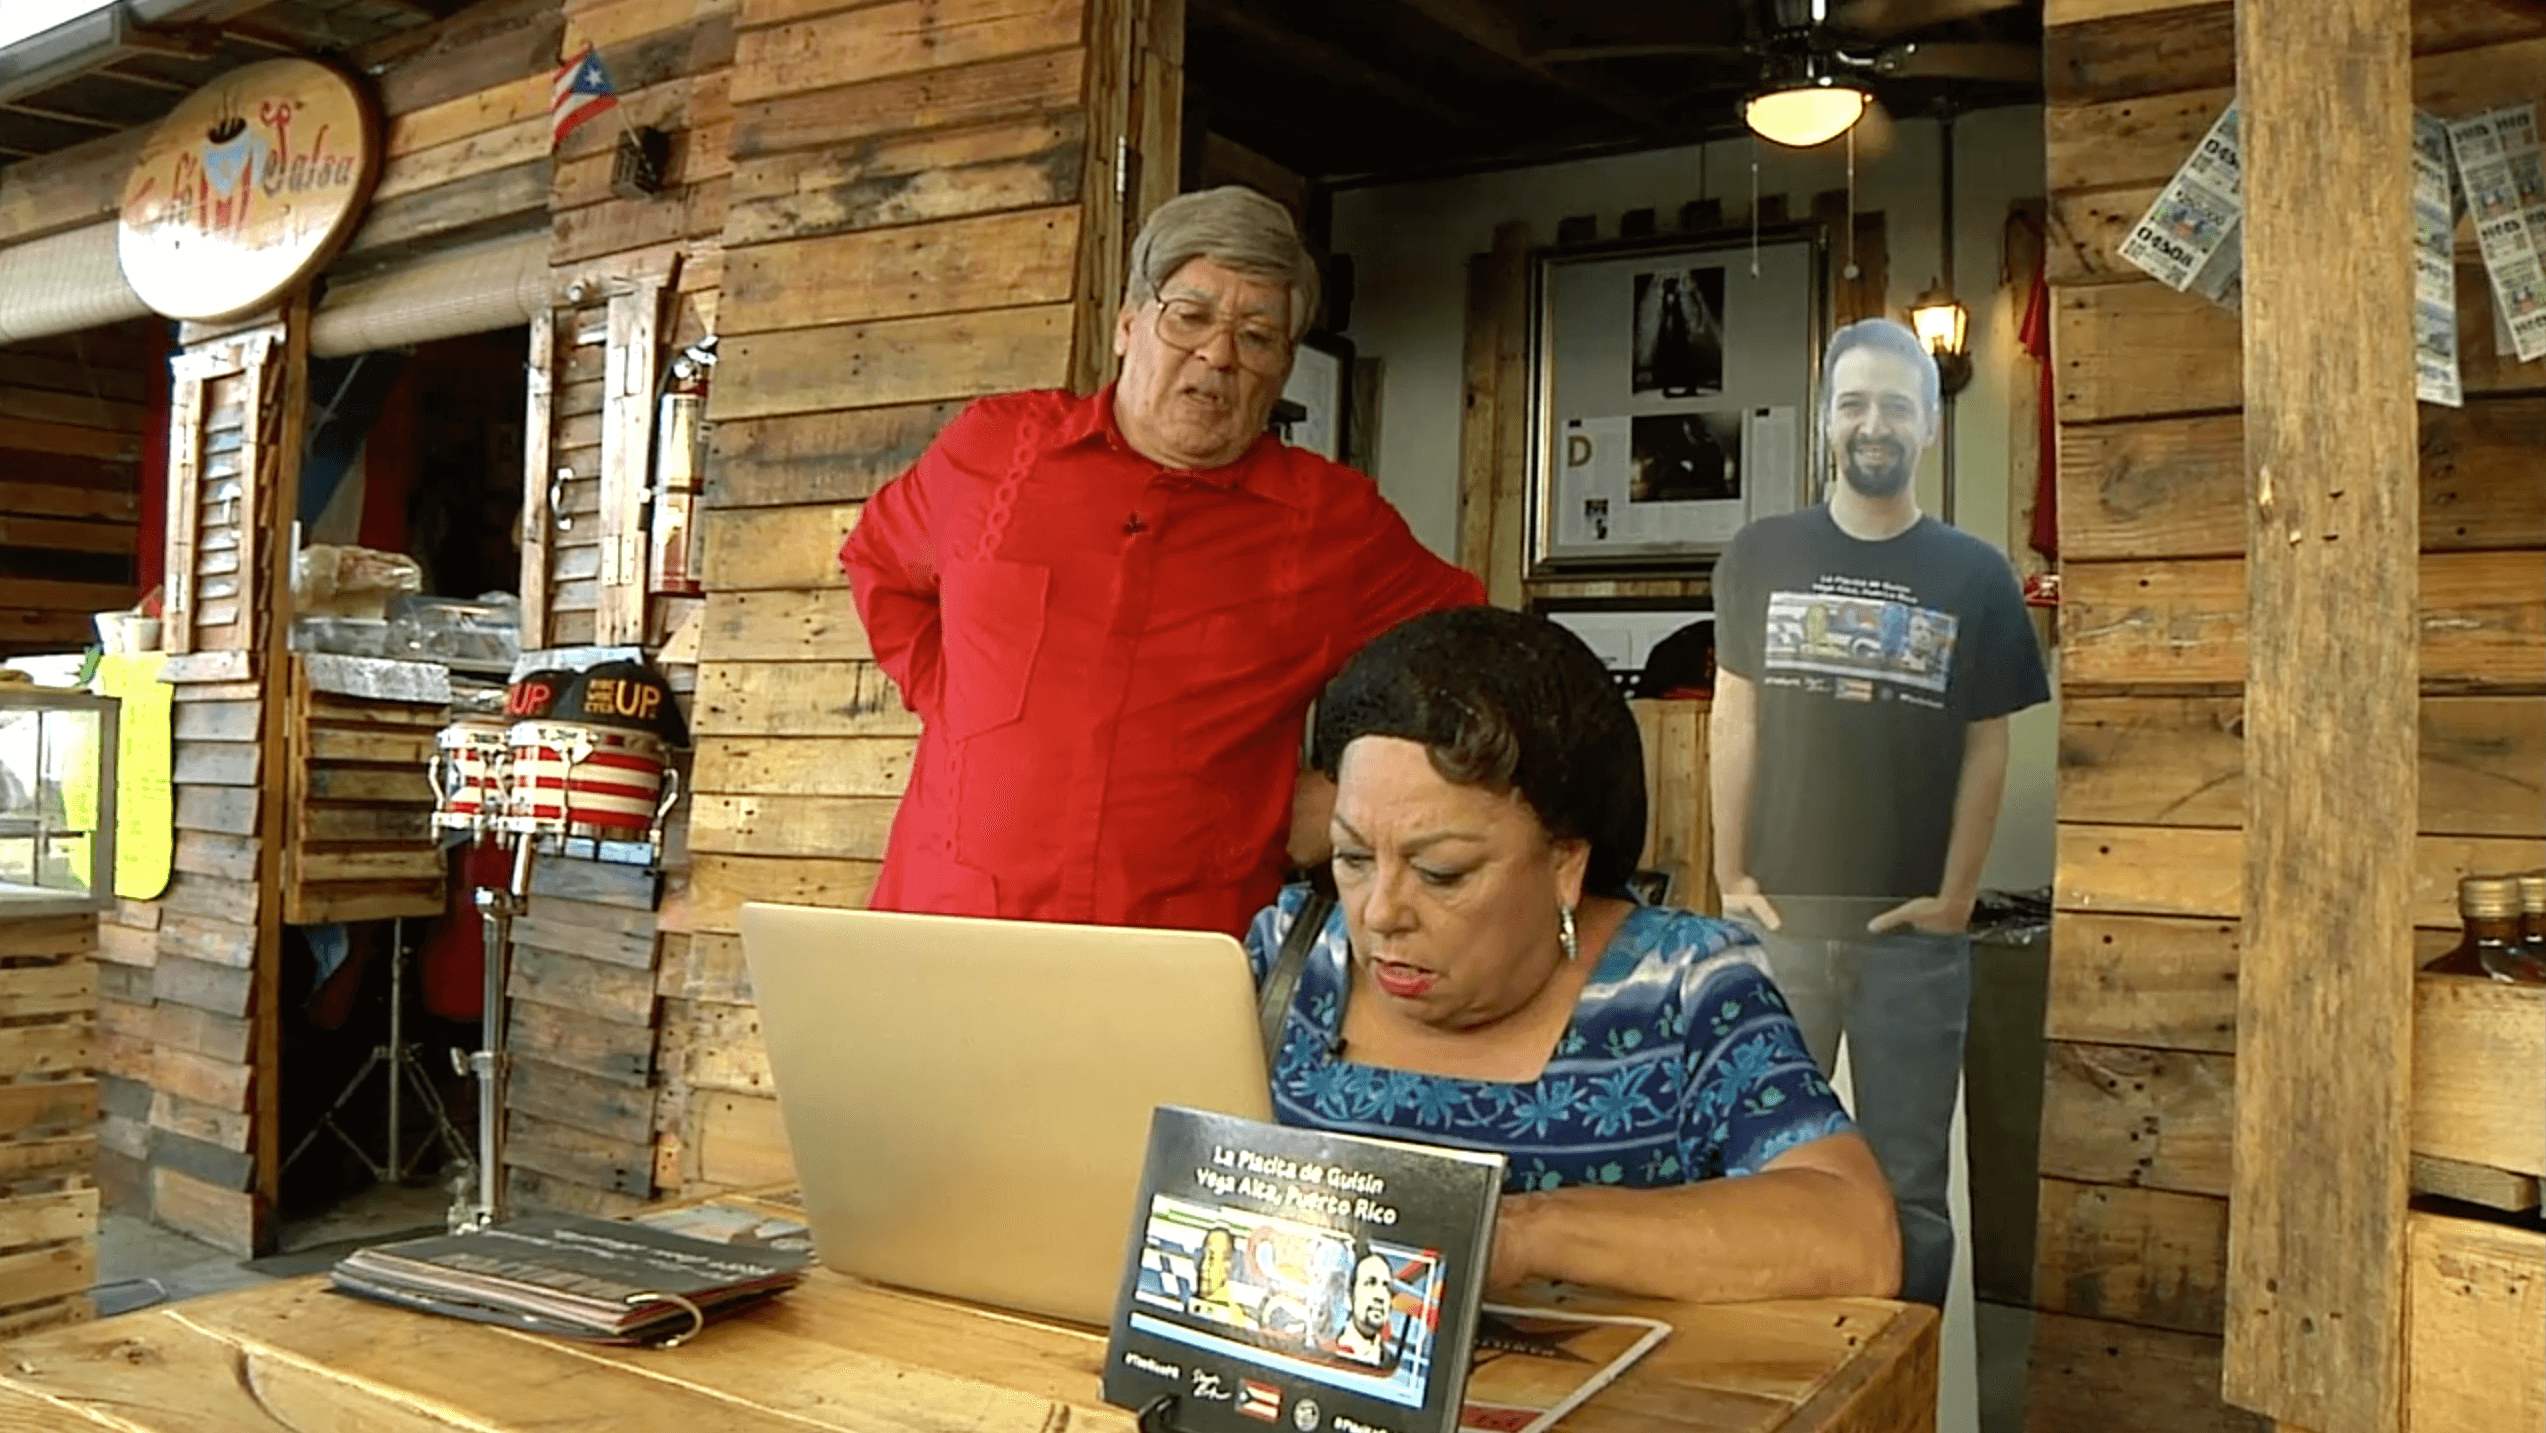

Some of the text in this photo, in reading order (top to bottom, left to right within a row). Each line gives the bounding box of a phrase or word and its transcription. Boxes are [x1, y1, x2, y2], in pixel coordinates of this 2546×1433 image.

[1567, 434, 1593, 468] D
[510, 682, 551, 716] UP
[615, 679, 661, 718] UP
[1213, 1145, 1235, 1167] La
[1238, 1150, 1297, 1179] Placita
[1300, 1162, 1324, 1184] de
[1196, 1168, 1398, 1225] Vega Alta, Puerto Rico
